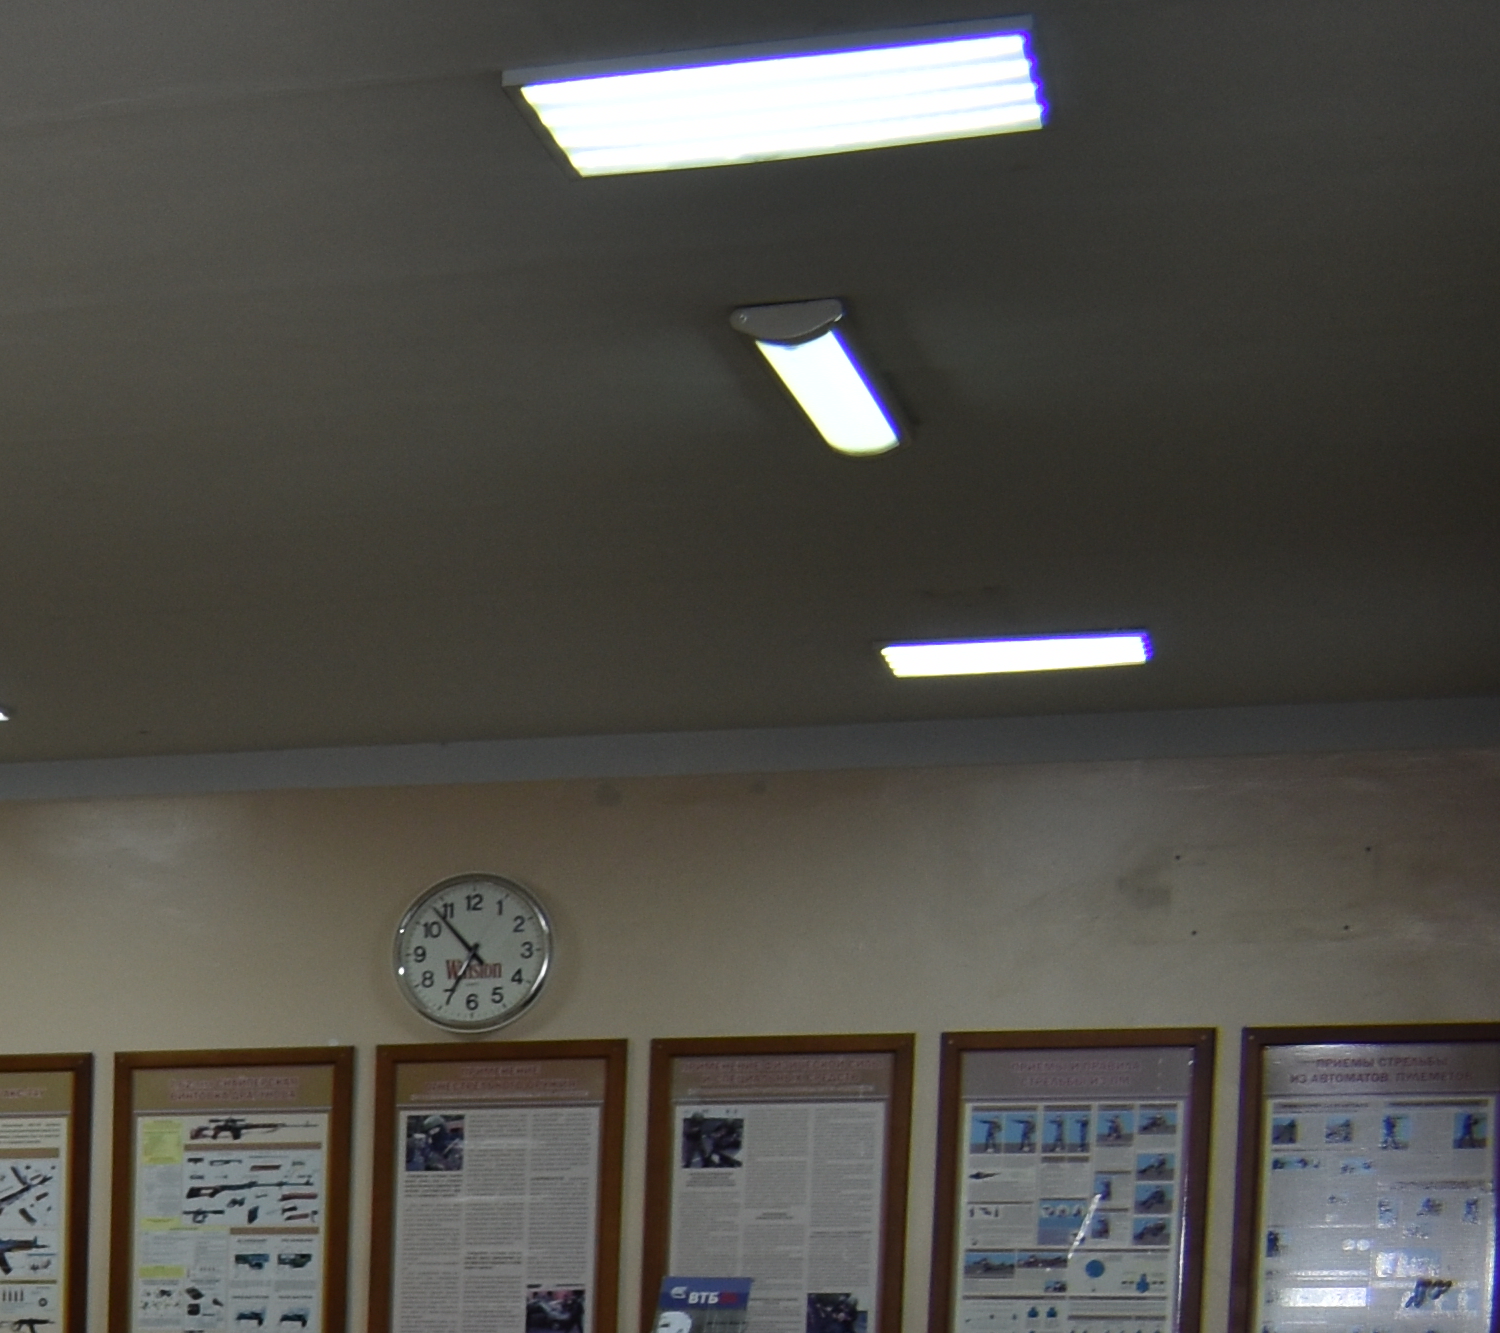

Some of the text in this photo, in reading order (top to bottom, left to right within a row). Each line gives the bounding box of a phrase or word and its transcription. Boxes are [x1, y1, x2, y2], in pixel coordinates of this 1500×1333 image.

[466, 894, 483, 911] 12
[497, 900, 503, 915] 1
[442, 903, 454, 919] 11
[423, 922, 442, 938] 10
[514, 916, 525, 932] 2
[414, 946, 426, 962] 9
[521, 942, 533, 958] 3
[446, 959, 502, 980] Wnston
[511, 969, 523, 985] 4
[422, 971, 434, 987] 8
[444, 989, 456, 1005] 7
[466, 994, 479, 1011] 6
[492, 987, 504, 1003] 5
[1315, 1056, 1448, 1068] ПРИЕМЫ СТРЕЛЬБЫ
[1290, 1074, 1307, 1083] ИЗ
